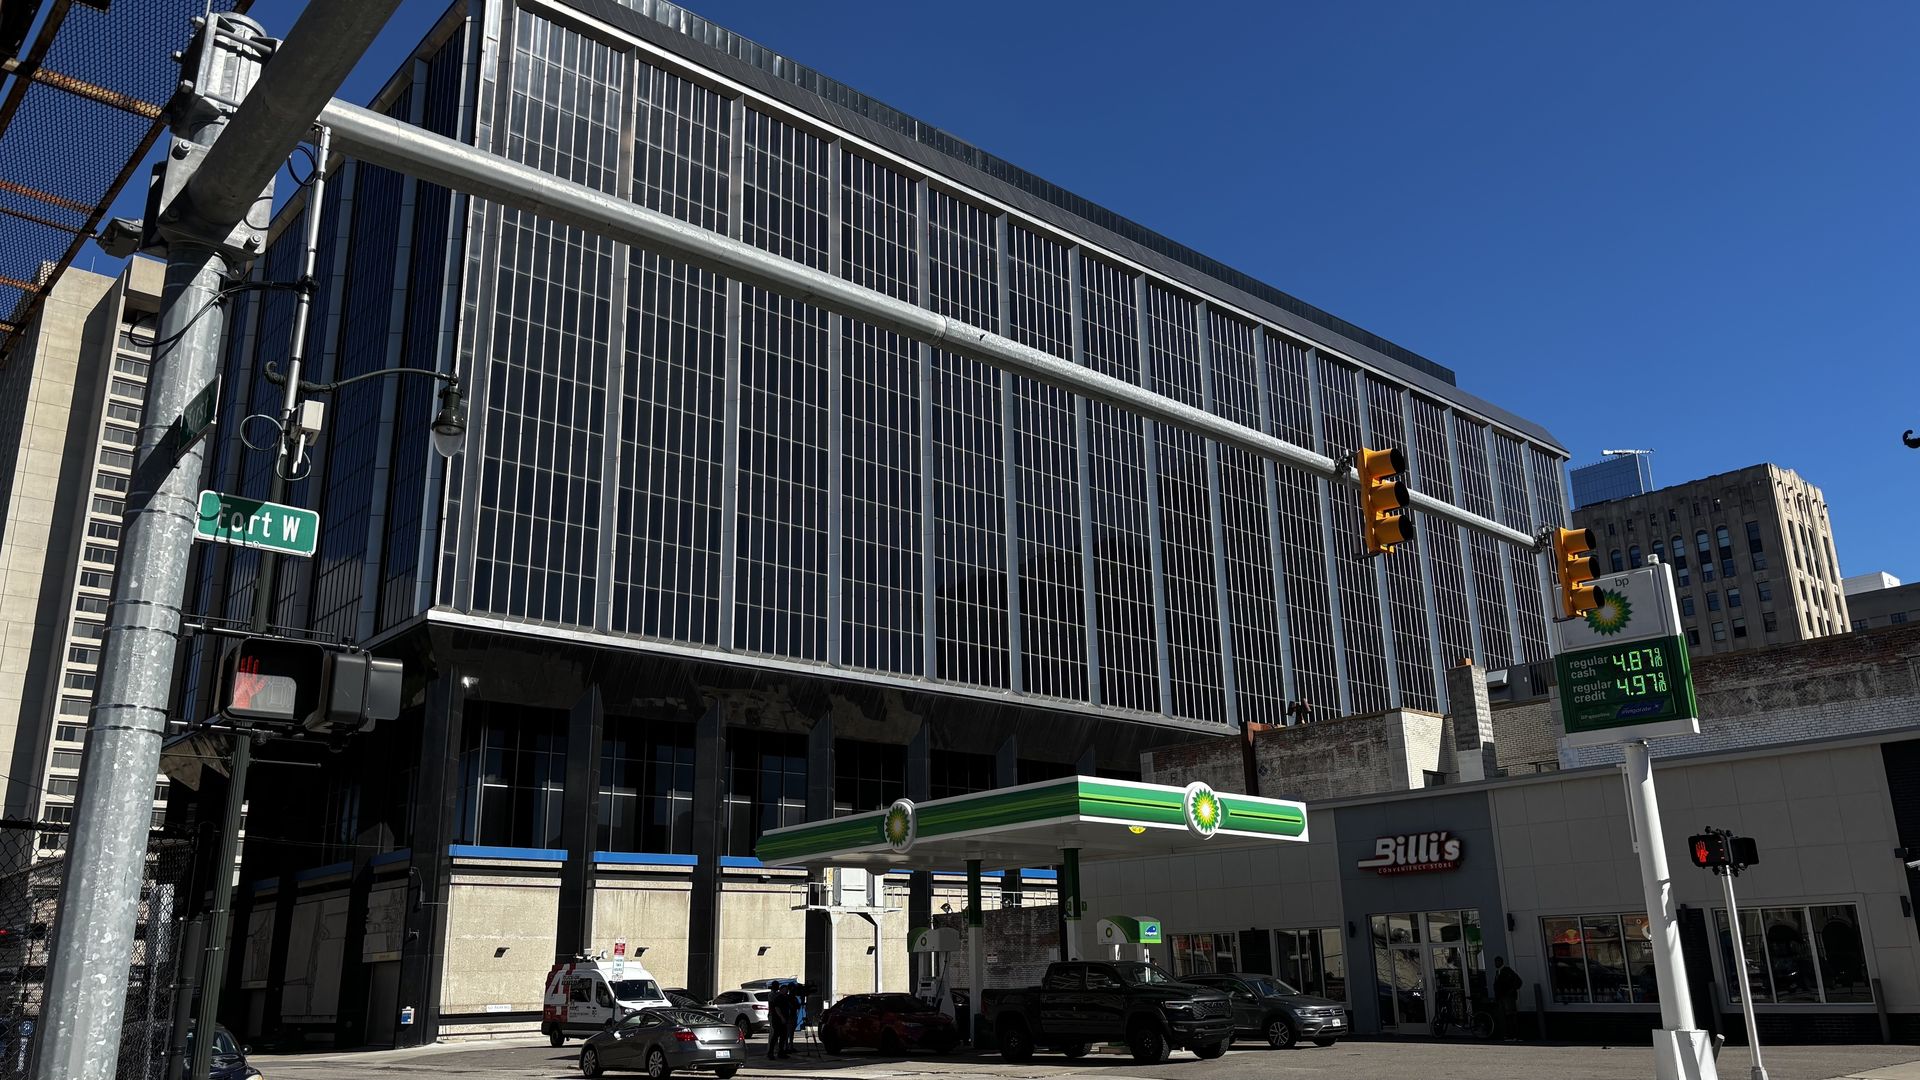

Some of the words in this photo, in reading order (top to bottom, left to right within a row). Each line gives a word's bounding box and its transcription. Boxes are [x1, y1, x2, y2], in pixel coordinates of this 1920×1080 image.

[217, 502, 273, 538] Fort
[282, 514, 301, 543] W
[1615, 577, 1629, 587] bp
[1569, 655, 1609, 669] regular
[1612, 648, 1655, 671] 4.87
[1571, 667, 1597, 679] cash
[1572, 680, 1612, 694] regular
[1616, 672, 1659, 696] 4.97
[1574, 690, 1607, 704] credit
[1358, 832, 1460, 867] Billi's
[1378, 864, 1426, 874] CONVENIENCE
[1430, 861, 1452, 870] STORE
